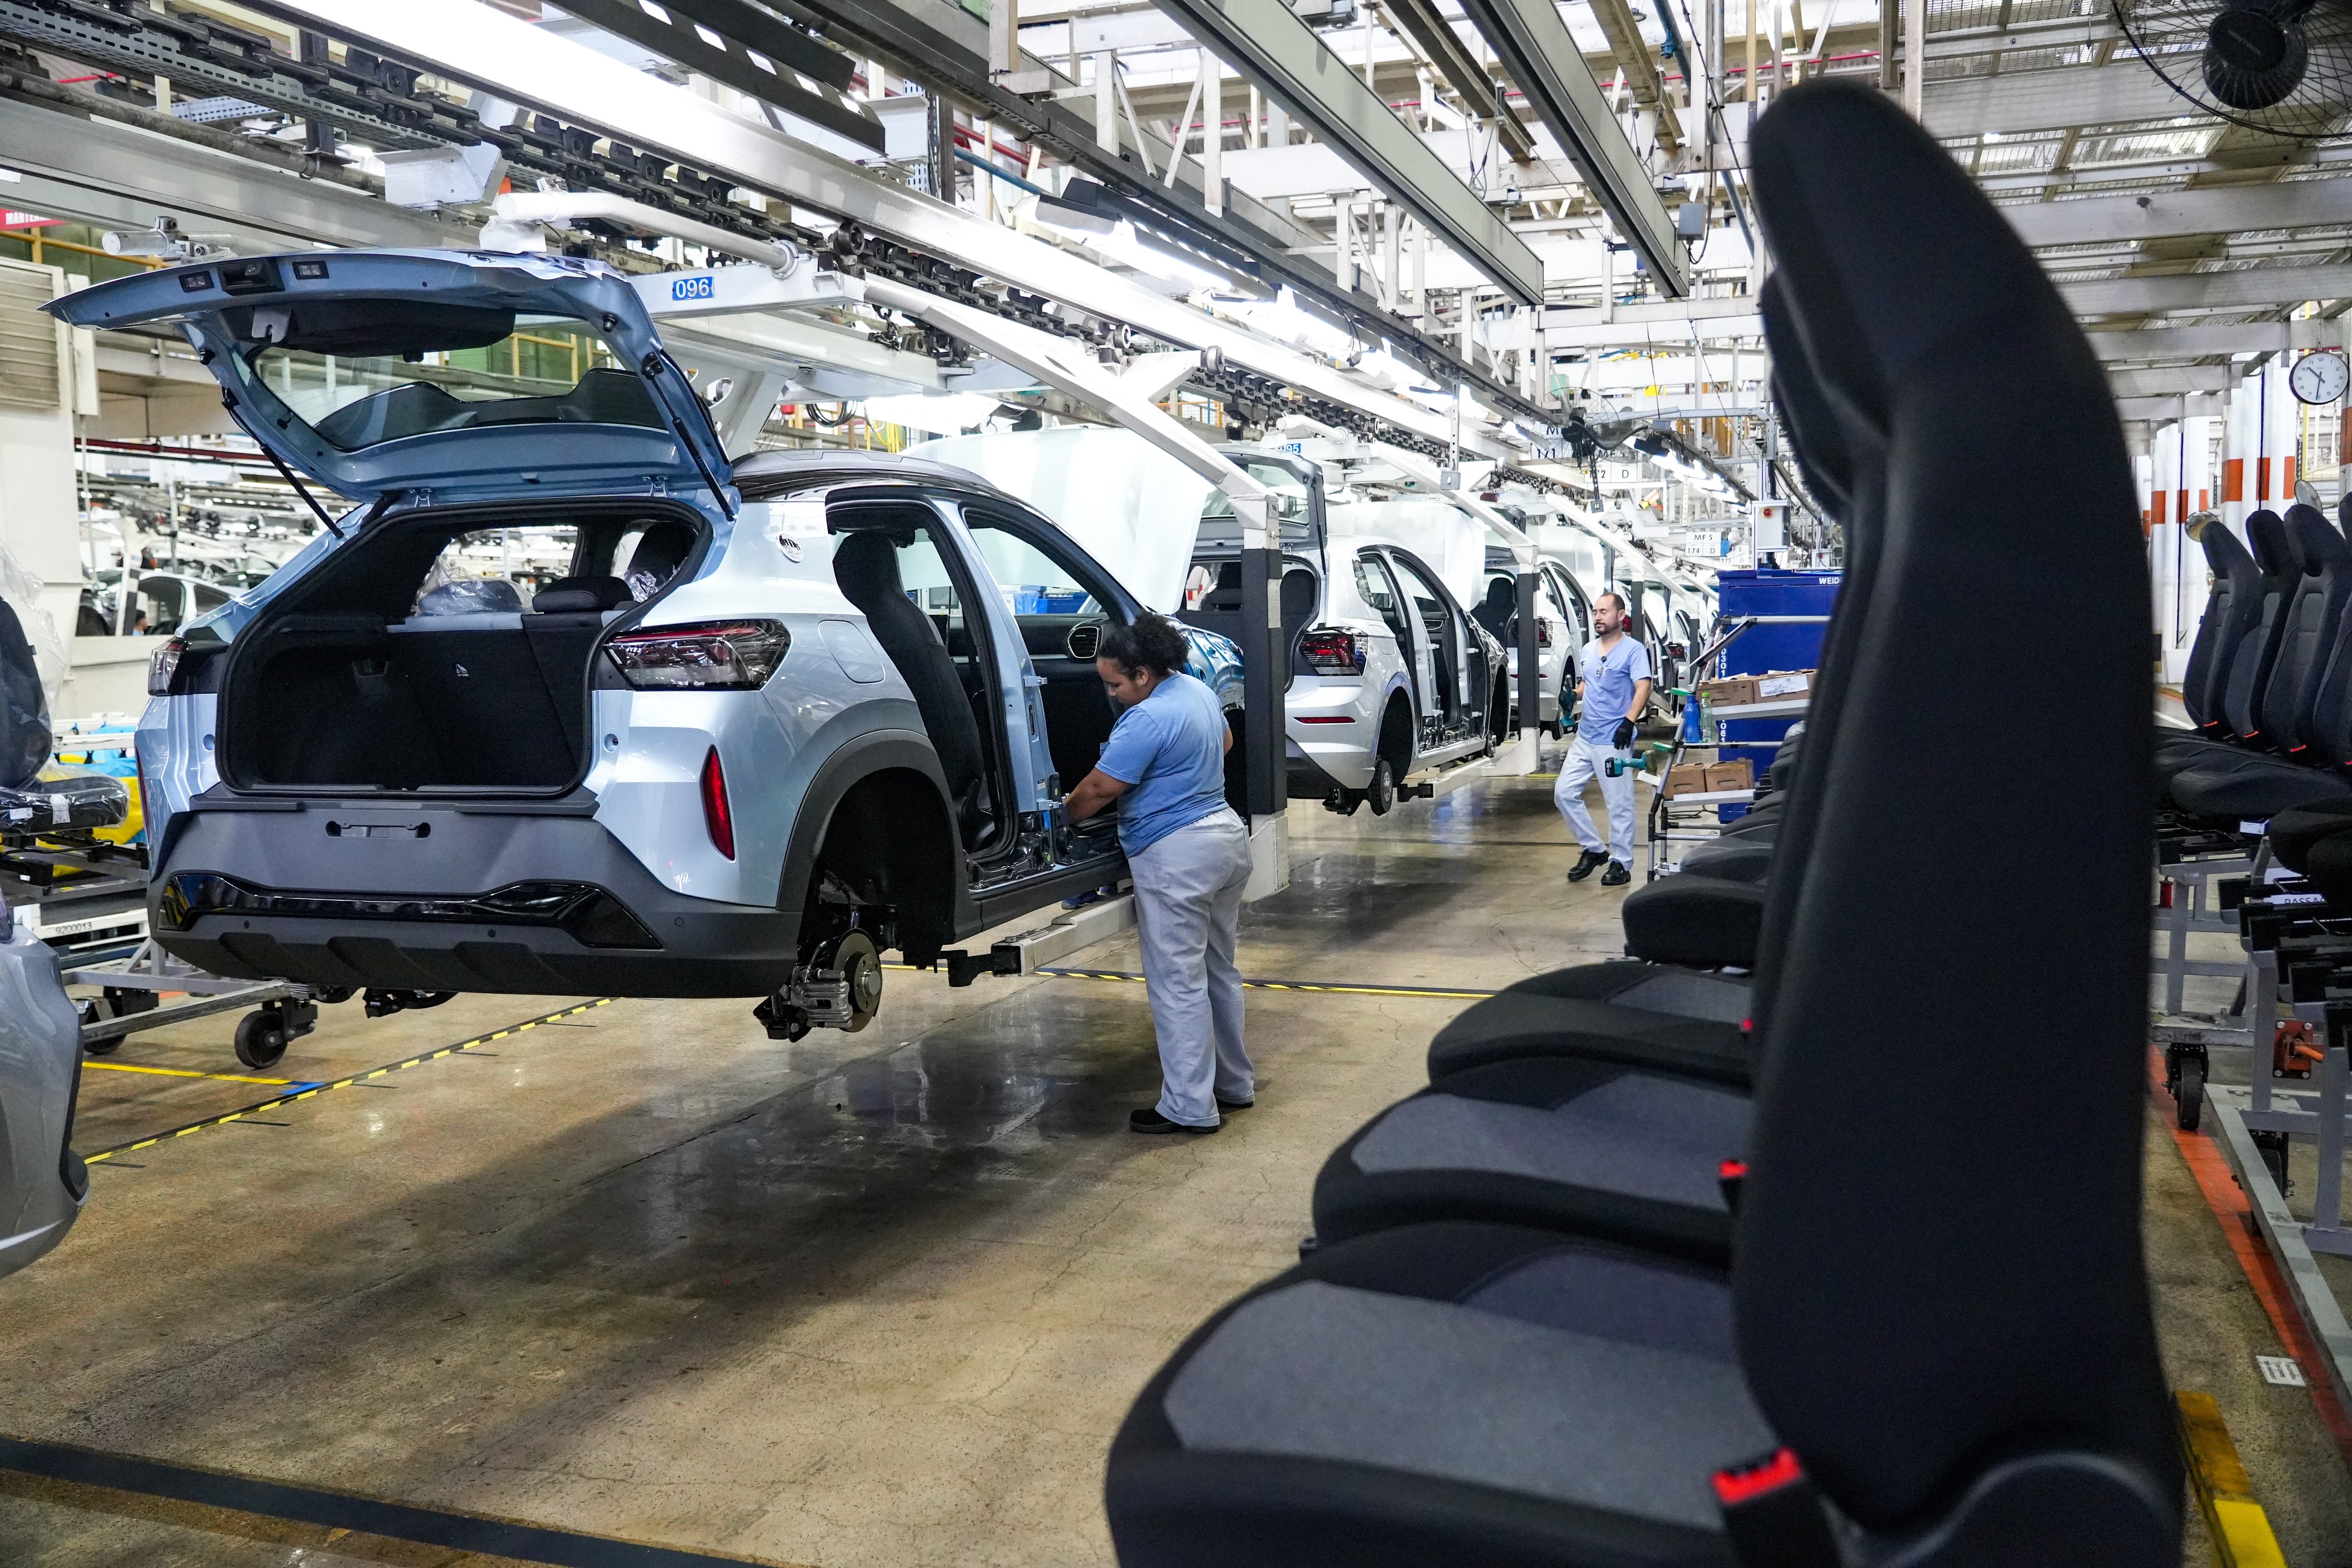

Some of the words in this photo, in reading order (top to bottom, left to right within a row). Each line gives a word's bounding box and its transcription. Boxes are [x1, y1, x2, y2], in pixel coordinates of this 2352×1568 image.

[676, 279, 709, 298] 096
[1589, 470, 1606, 479] 12
[1622, 470, 1629, 479] D
